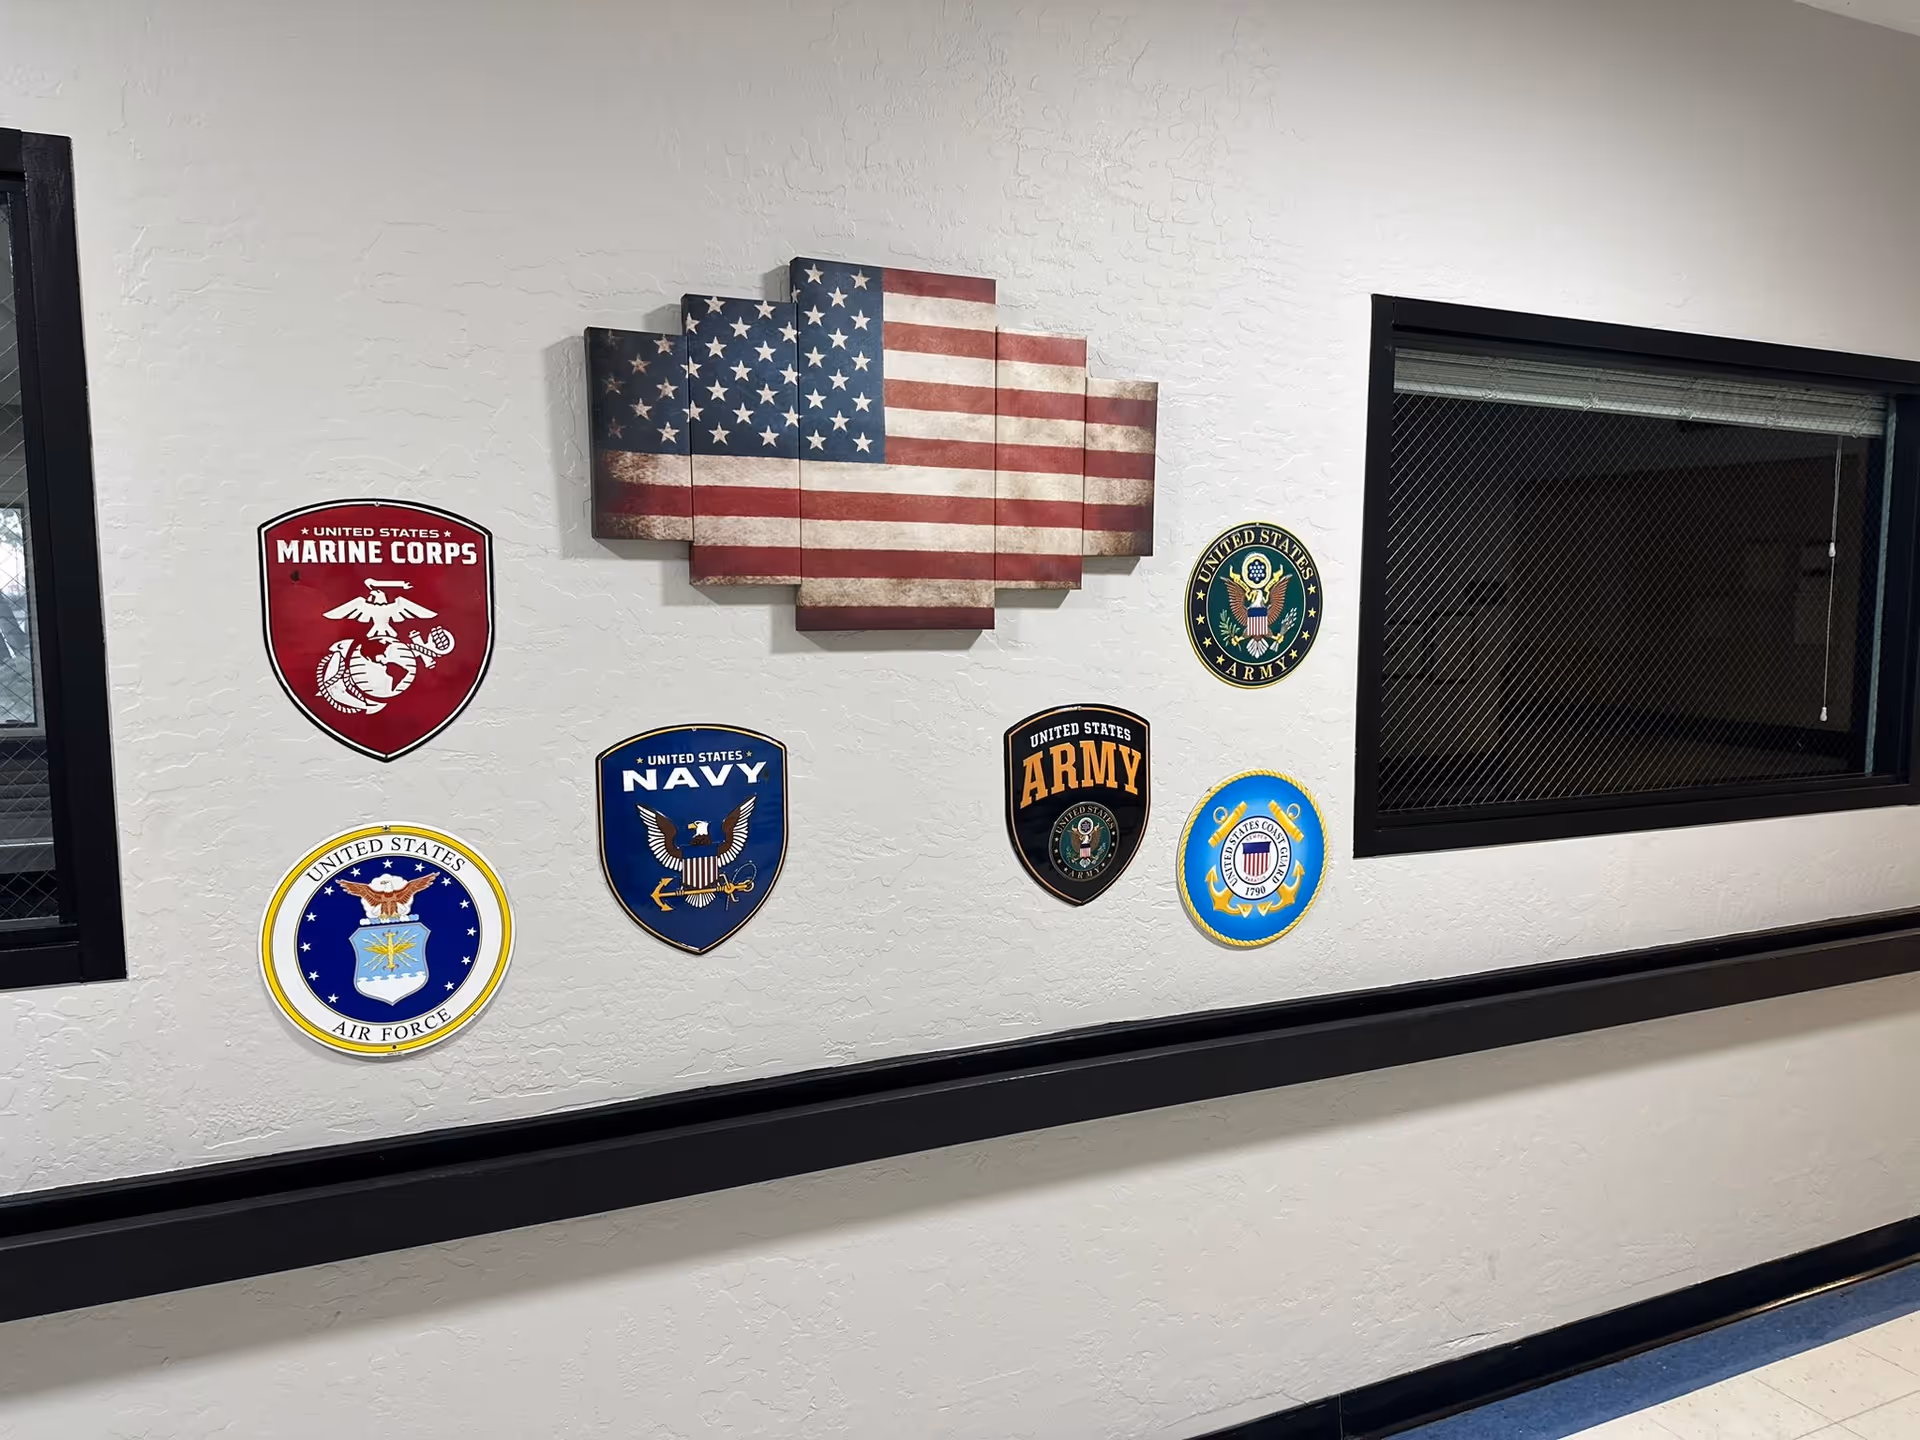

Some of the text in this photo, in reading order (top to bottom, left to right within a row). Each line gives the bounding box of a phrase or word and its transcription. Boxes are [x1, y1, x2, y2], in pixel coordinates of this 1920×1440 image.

[313, 527, 440, 538] UNITED STATES
[276, 539, 478, 565] MARINE CORPS
[1198, 529, 1314, 583] UNITED STATES
[1226, 656, 1288, 681] ARMY
[1029, 722, 1132, 748] UNITED STATES
[647, 750, 743, 765] UNITED STATES
[622, 761, 767, 792] NAVY
[1019, 740, 1142, 809] ARMY
[1056, 805, 1116, 834] UNITED STATES
[306, 837, 466, 882] UNITED STATES
[1223, 820, 1289, 887] UNITED STATES COAST GUARD
[1069, 867, 1101, 879] ARMY
[1244, 885, 1266, 896] 1790
[332, 1008, 451, 1042] AIR FORCE
